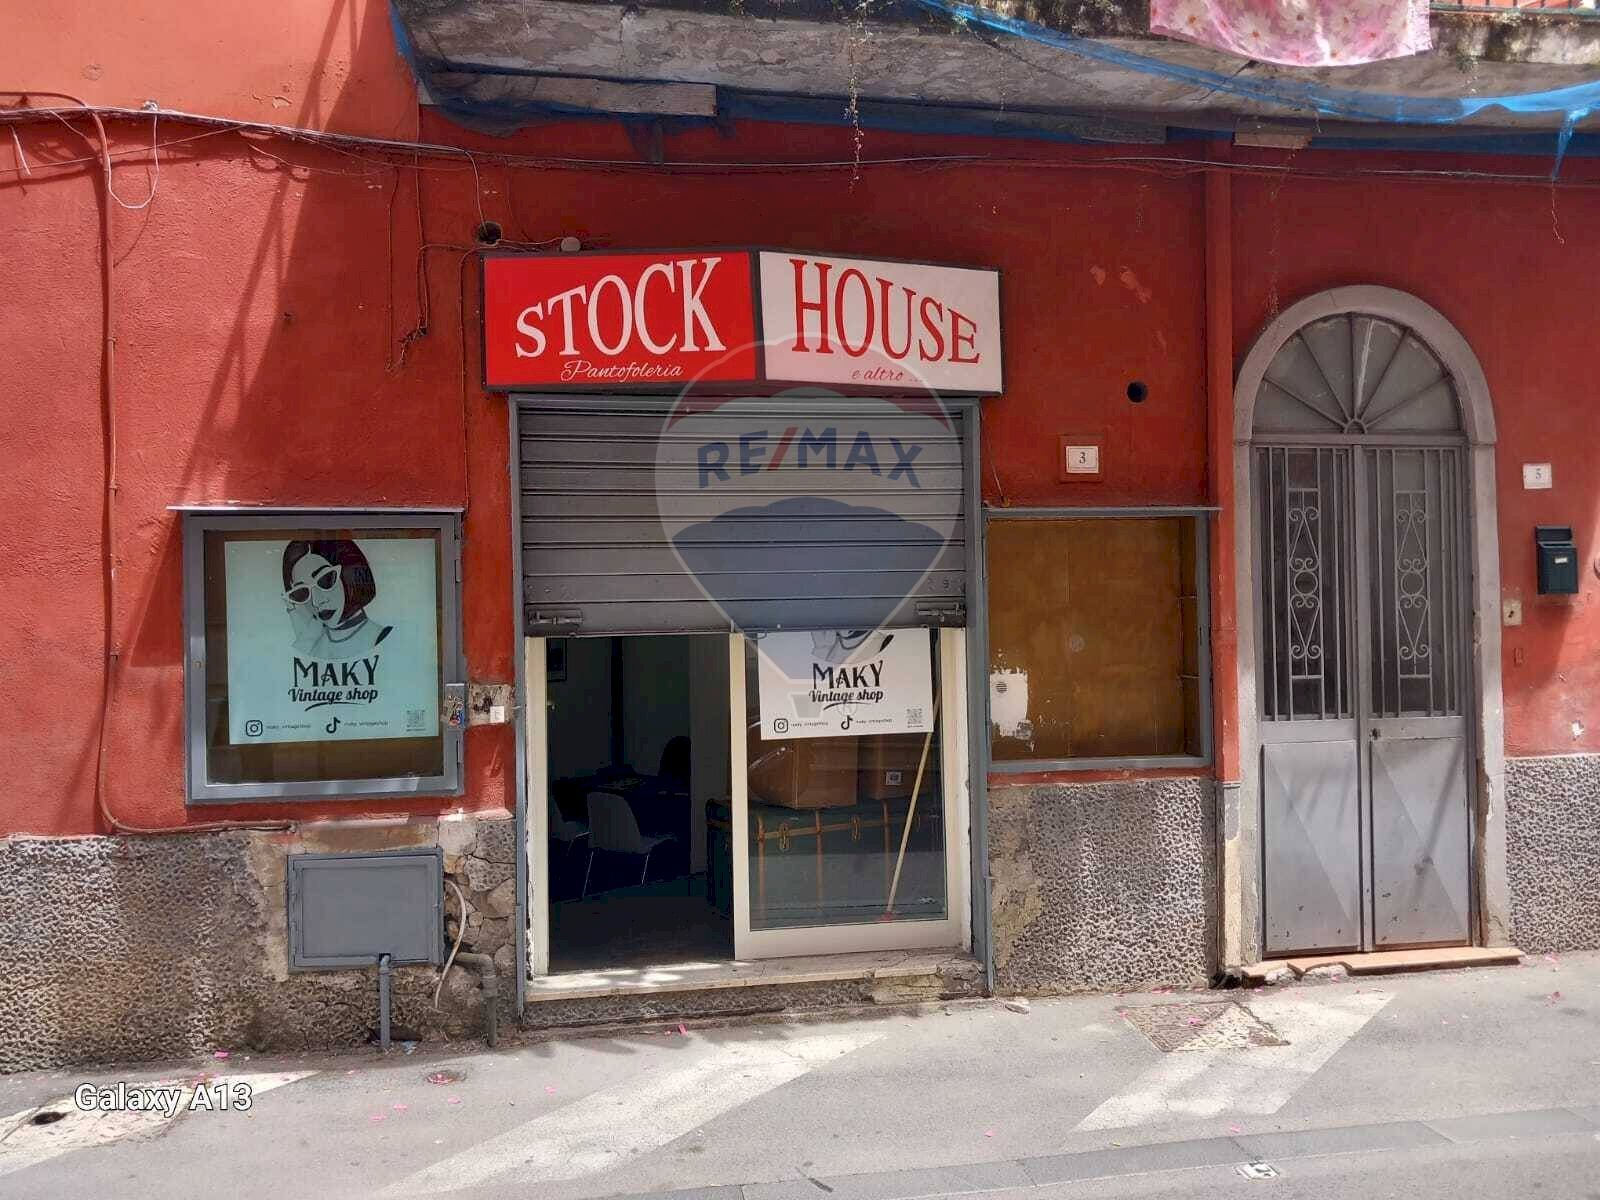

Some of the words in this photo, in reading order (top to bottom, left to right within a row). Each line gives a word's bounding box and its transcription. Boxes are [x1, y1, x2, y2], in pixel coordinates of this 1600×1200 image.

[514, 256, 727, 358] STOCK
[789, 258, 981, 364] HOUSE
[560, 359, 683, 382] Pantofoleria
[852, 369, 862, 380] e
[863, 366, 904, 381] altro
[1079, 451, 1087, 464] 3
[1535, 467, 1542, 480] 5
[293, 654, 380, 688] MAKY
[812, 659, 884, 690] MAKY
[288, 688, 343, 705] Vintage
[345, 687, 379, 704] shop
[808, 689, 855, 704] Vintage
[856, 688, 884, 703] shop
